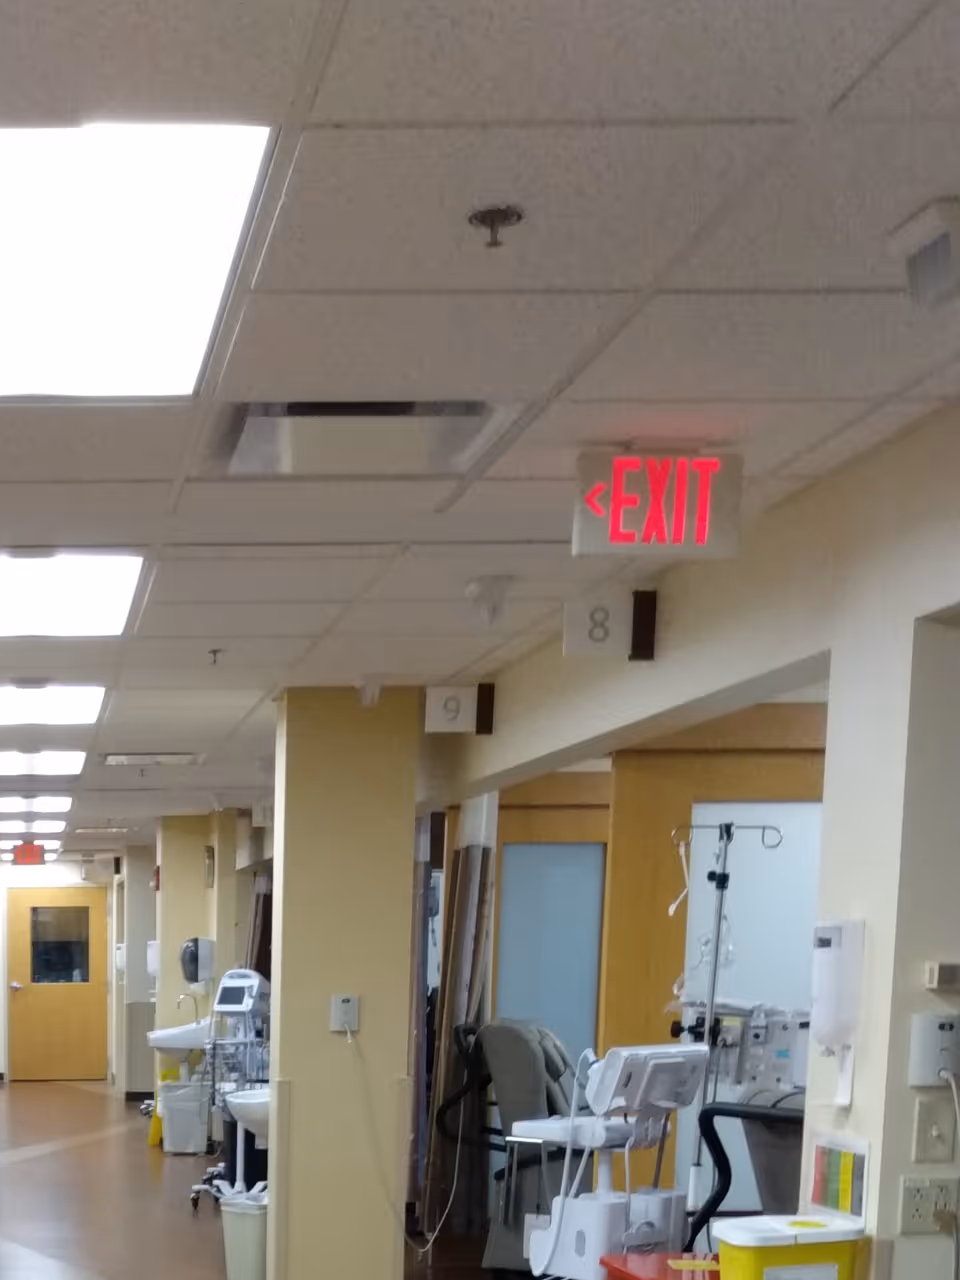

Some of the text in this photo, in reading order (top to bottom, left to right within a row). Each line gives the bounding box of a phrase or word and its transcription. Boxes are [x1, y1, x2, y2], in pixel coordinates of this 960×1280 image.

[610, 457, 721, 545] EXIT
[588, 606, 610, 643] 8
[442, 695, 461, 722] 9
